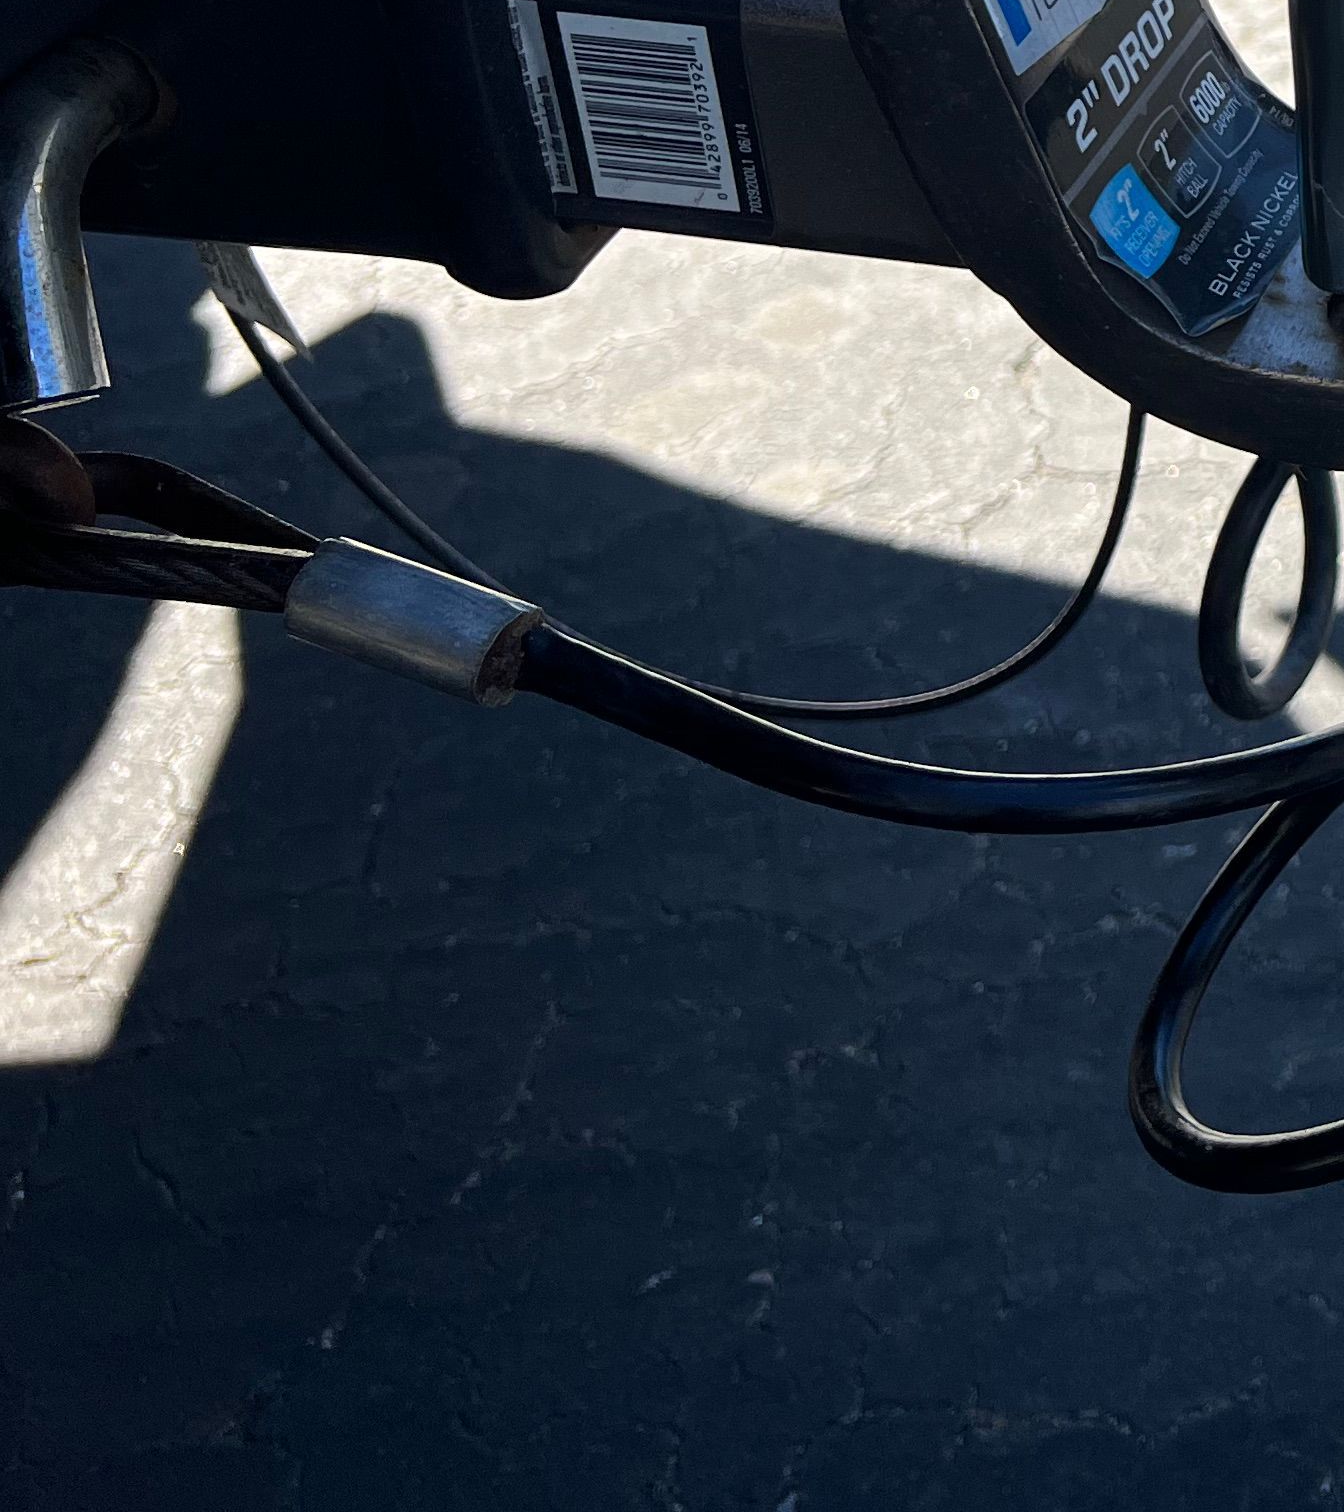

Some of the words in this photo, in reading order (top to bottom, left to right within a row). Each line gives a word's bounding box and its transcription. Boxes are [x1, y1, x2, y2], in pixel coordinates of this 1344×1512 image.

[690, 60, 711, 113] 70392
[1189, 71, 1226, 124] 6000
[1066, 80, 1100, 154] 2"
[1212, 97, 1242, 136] CAPACITY
[701, 122, 722, 173] 42899
[1154, 128, 1176, 170] 2"
[1175, 157, 1198, 185] HITCH
[1187, 176, 1209, 199] BALL
[1209, 230, 1260, 296] BLACK
[1232, 261, 1262, 299] RESISTS
